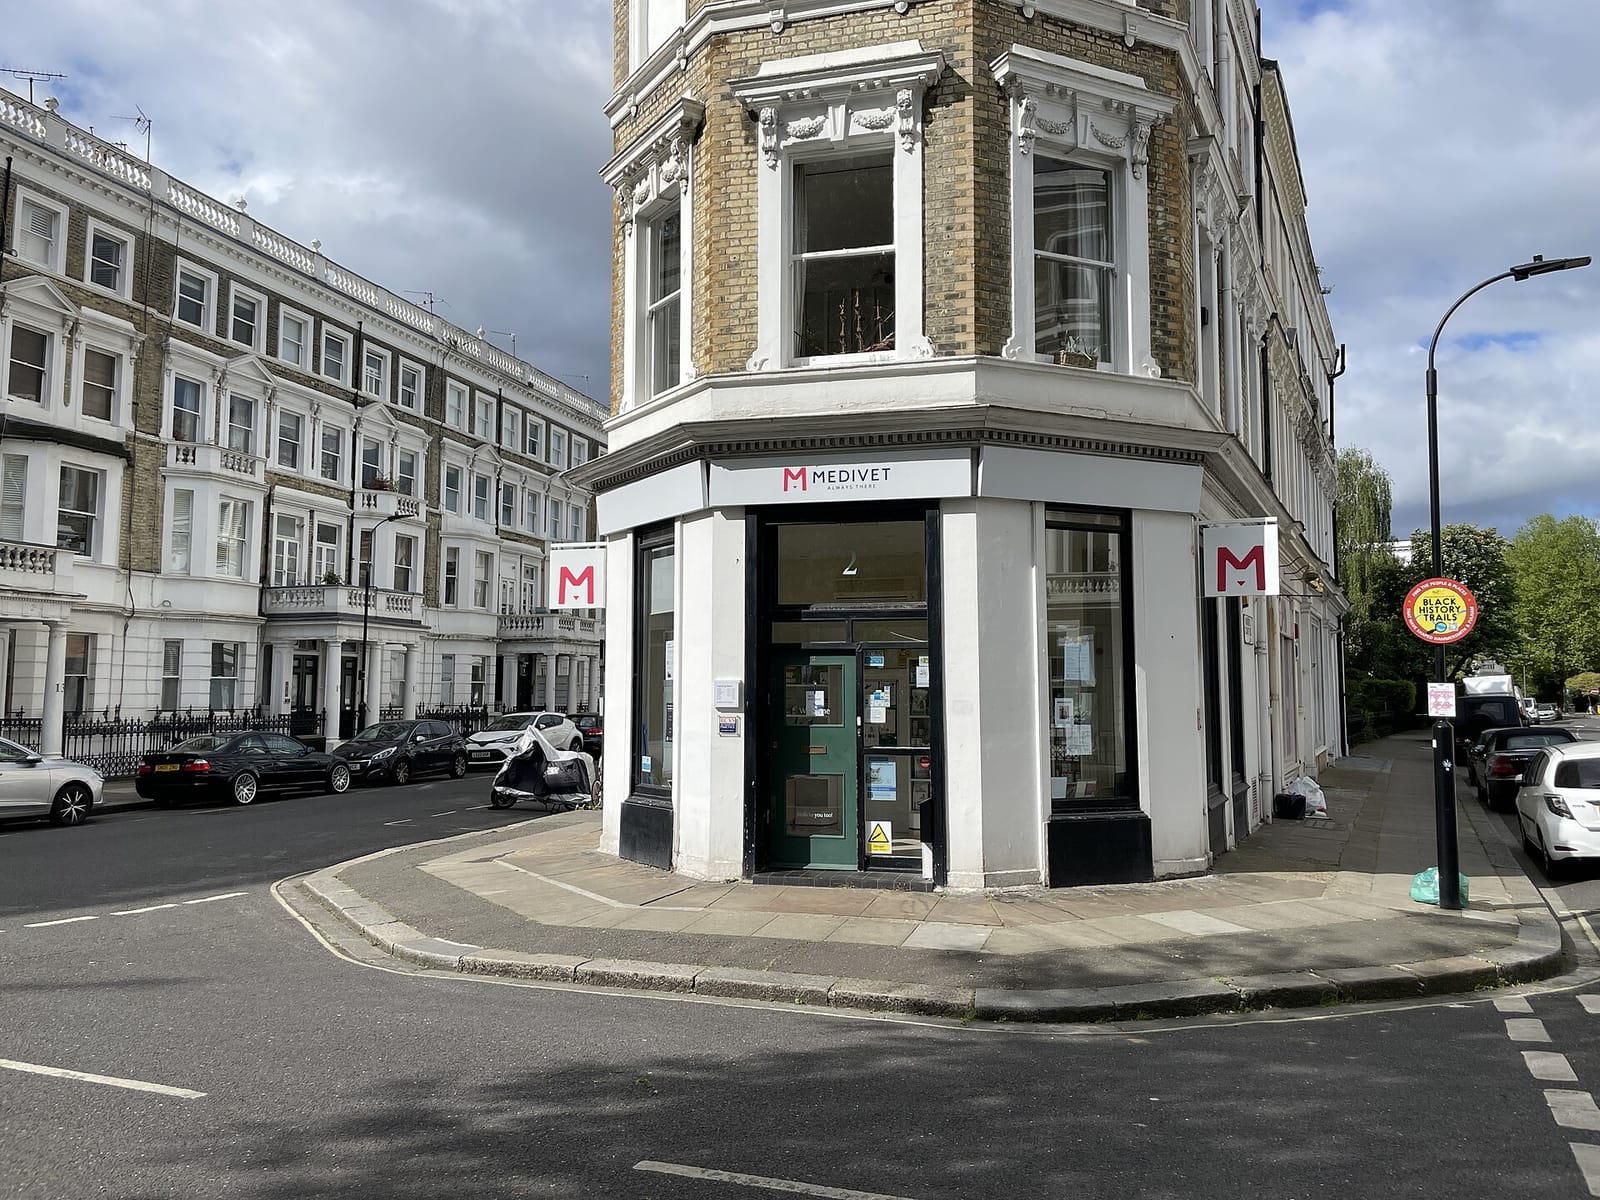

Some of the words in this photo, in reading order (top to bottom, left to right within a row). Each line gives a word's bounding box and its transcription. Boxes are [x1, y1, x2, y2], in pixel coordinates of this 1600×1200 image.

[813, 468, 891, 484] MEDIVET
[842, 550, 858, 575] 2
[1452, 584, 1467, 596] PLACES
[1423, 598, 1456, 606] BLACK
[1419, 606, 1461, 614] HISTORY
[1424, 614, 1457, 622] TRAILS
[1416, 629, 1433, 640] SHAPED
